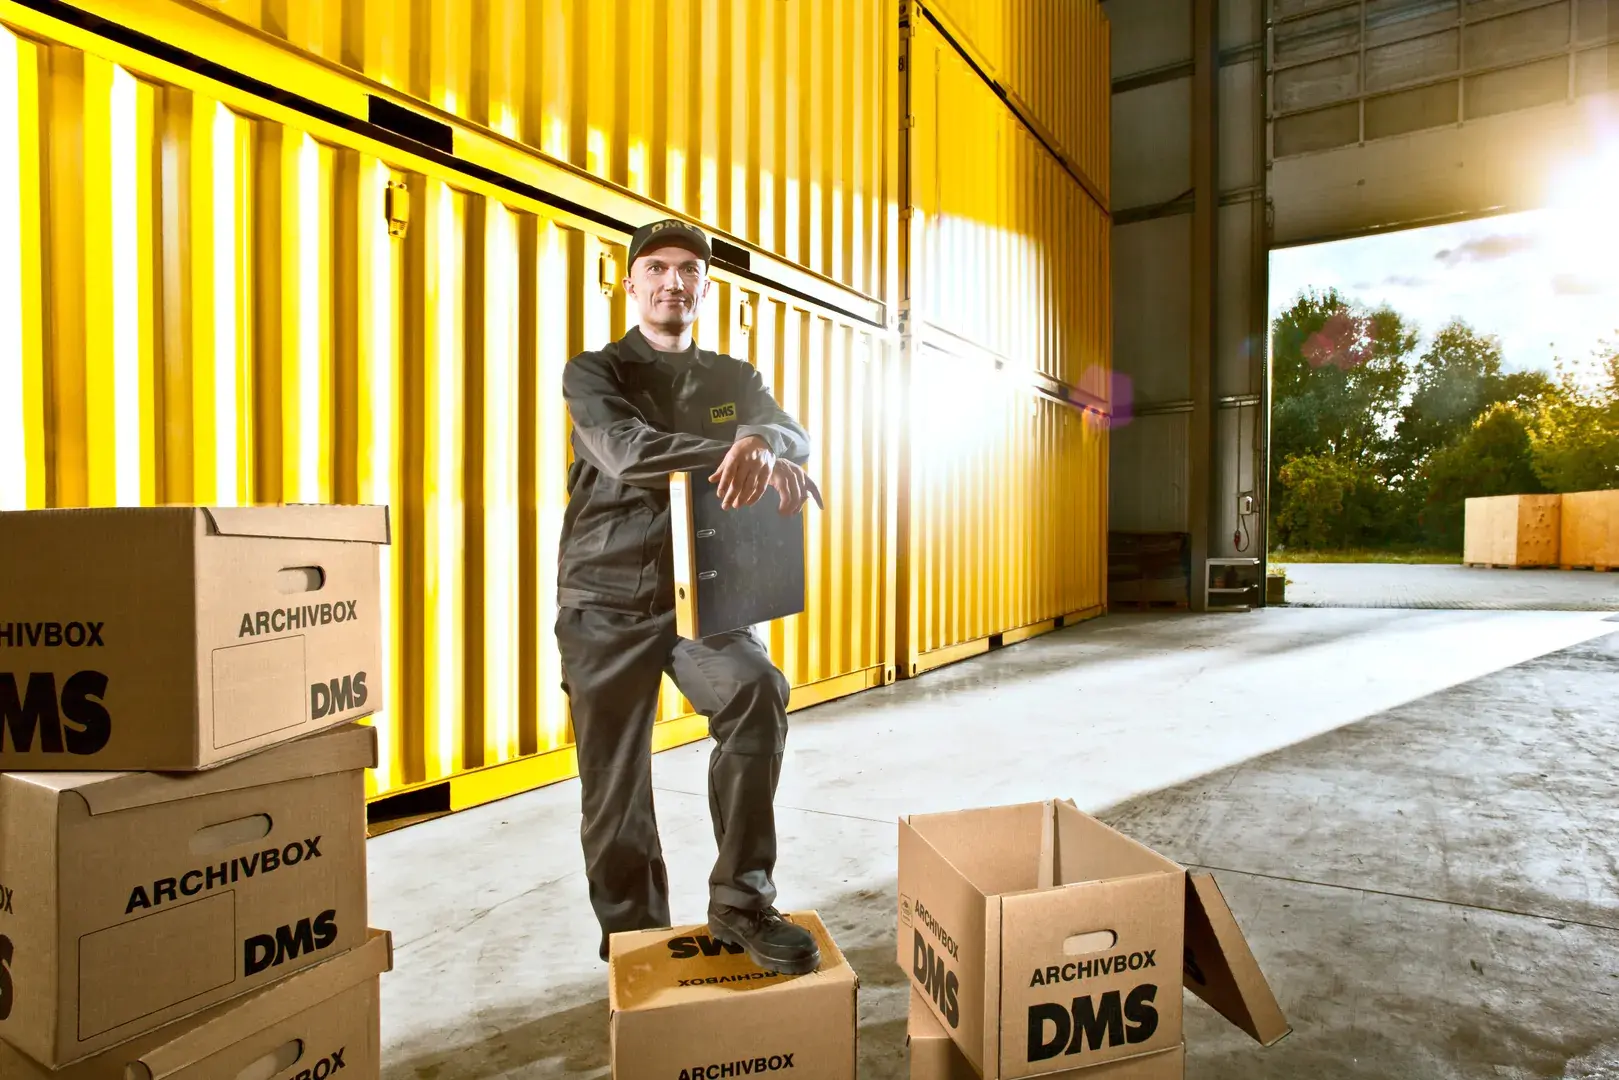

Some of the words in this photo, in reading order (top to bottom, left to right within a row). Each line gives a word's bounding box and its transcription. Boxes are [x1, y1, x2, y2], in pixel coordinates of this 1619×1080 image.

[712, 405, 734, 419] DMS
[238, 599, 358, 638] ARCHIVBOX
[310, 670, 368, 721] DMS
[124, 835, 323, 915] ARCHIVBOX
[244, 909, 338, 978] DMS
[667, 935, 746, 959] MS
[914, 899, 960, 963] ARCHIVBOX
[677, 970, 779, 987] RCHIVBOX
[913, 927, 960, 1030] DMS
[1029, 949, 1157, 988] ARCHIVBOX
[1027, 983, 1159, 1063] DMS
[678, 1053, 795, 1080] ARCHIVBOX
